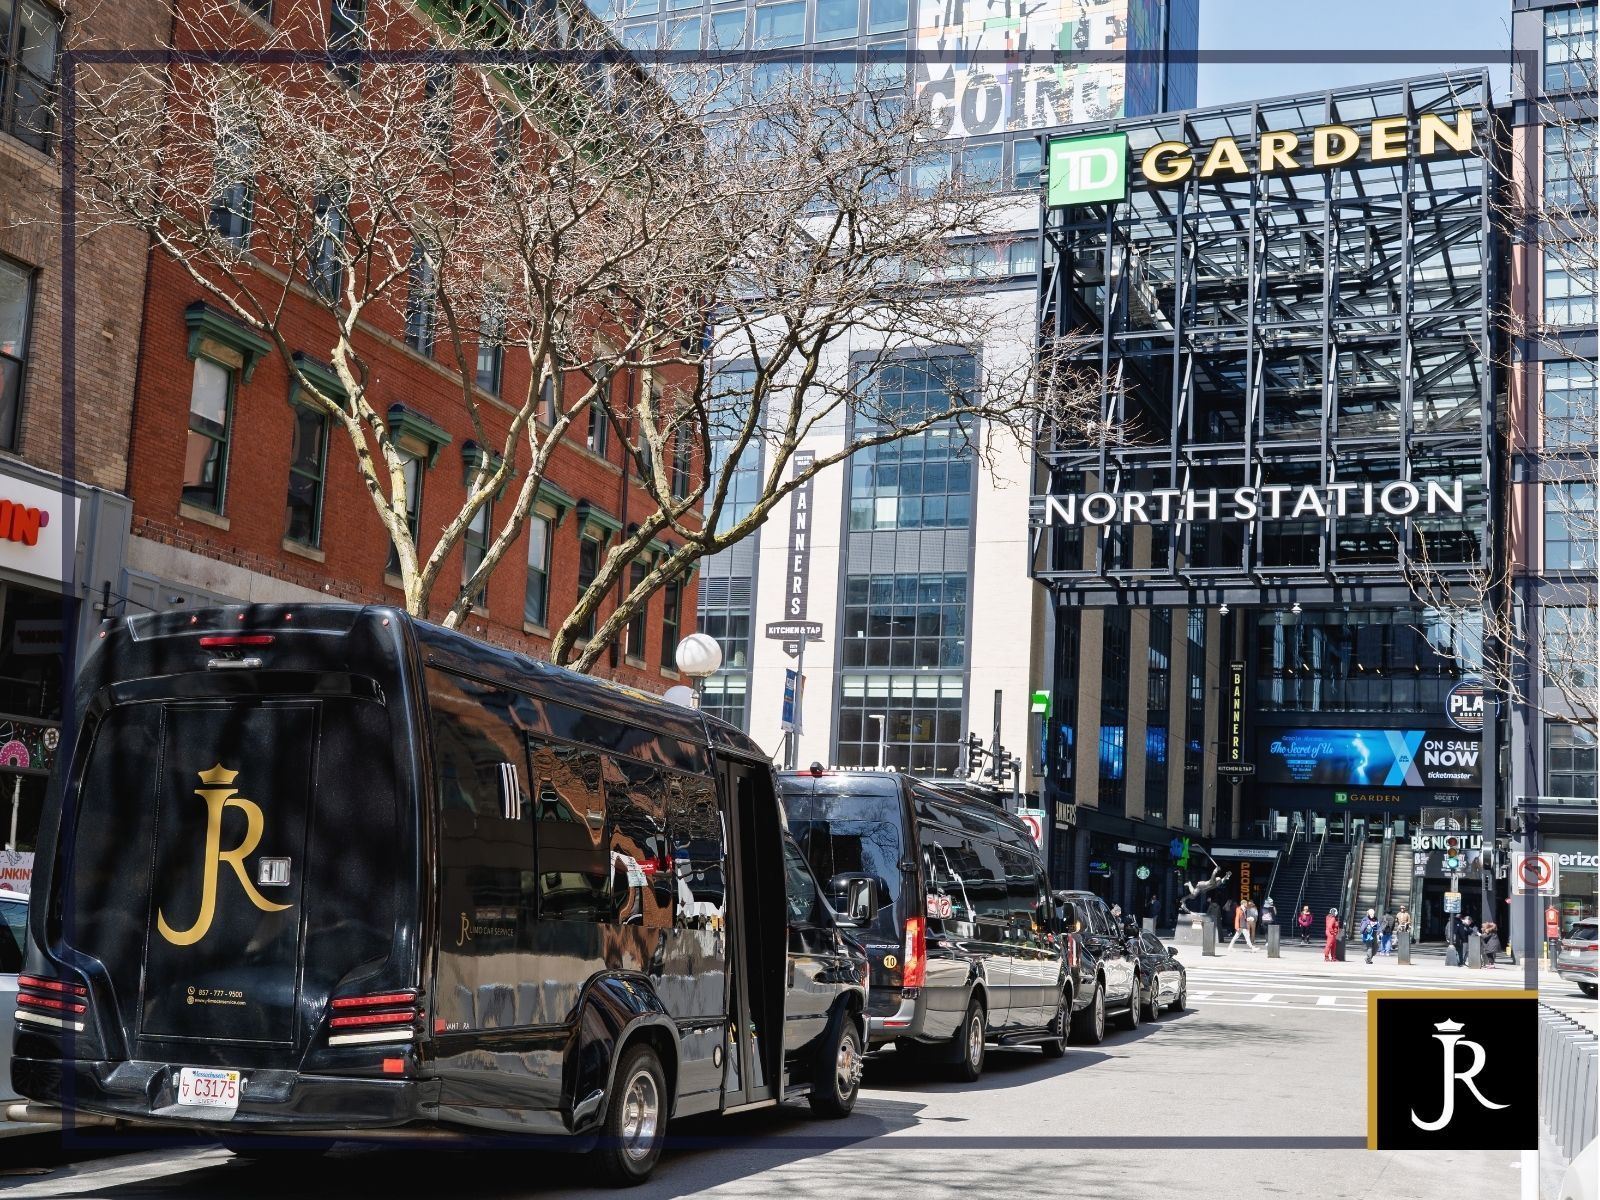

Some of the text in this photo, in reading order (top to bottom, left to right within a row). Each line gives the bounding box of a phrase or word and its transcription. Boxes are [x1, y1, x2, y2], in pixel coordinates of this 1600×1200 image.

[1056, 109, 1474, 192] TD GARDEN
[1044, 479, 1463, 525] NORTH STATION
[790, 471, 808, 615] ANNERS
[768, 626, 800, 634] KITCHEN
[806, 626, 821, 634] TAP
[1450, 694, 1484, 713] PLA
[1232, 673, 1241, 760] BANNERS
[1270, 741, 1286, 754] The
[1287, 741, 1311, 754] Secret
[1320, 743, 1334, 754] Us
[1424, 740, 1479, 751] ON SALE
[1424, 750, 1479, 767] NOW
[1427, 771, 1472, 780] ticketmaster
[1335, 793, 1400, 802] TD GARDEN
[1055, 800, 1077, 826] ANNERS
[1411, 835, 1430, 850] BIG
[1431, 835, 1468, 849] NIT
[1559, 851, 1598, 867] erizo
[1240, 862, 1251, 900] PROSH
[885, 957, 895, 967] 10
[194, 1078, 236, 1099] C3175
